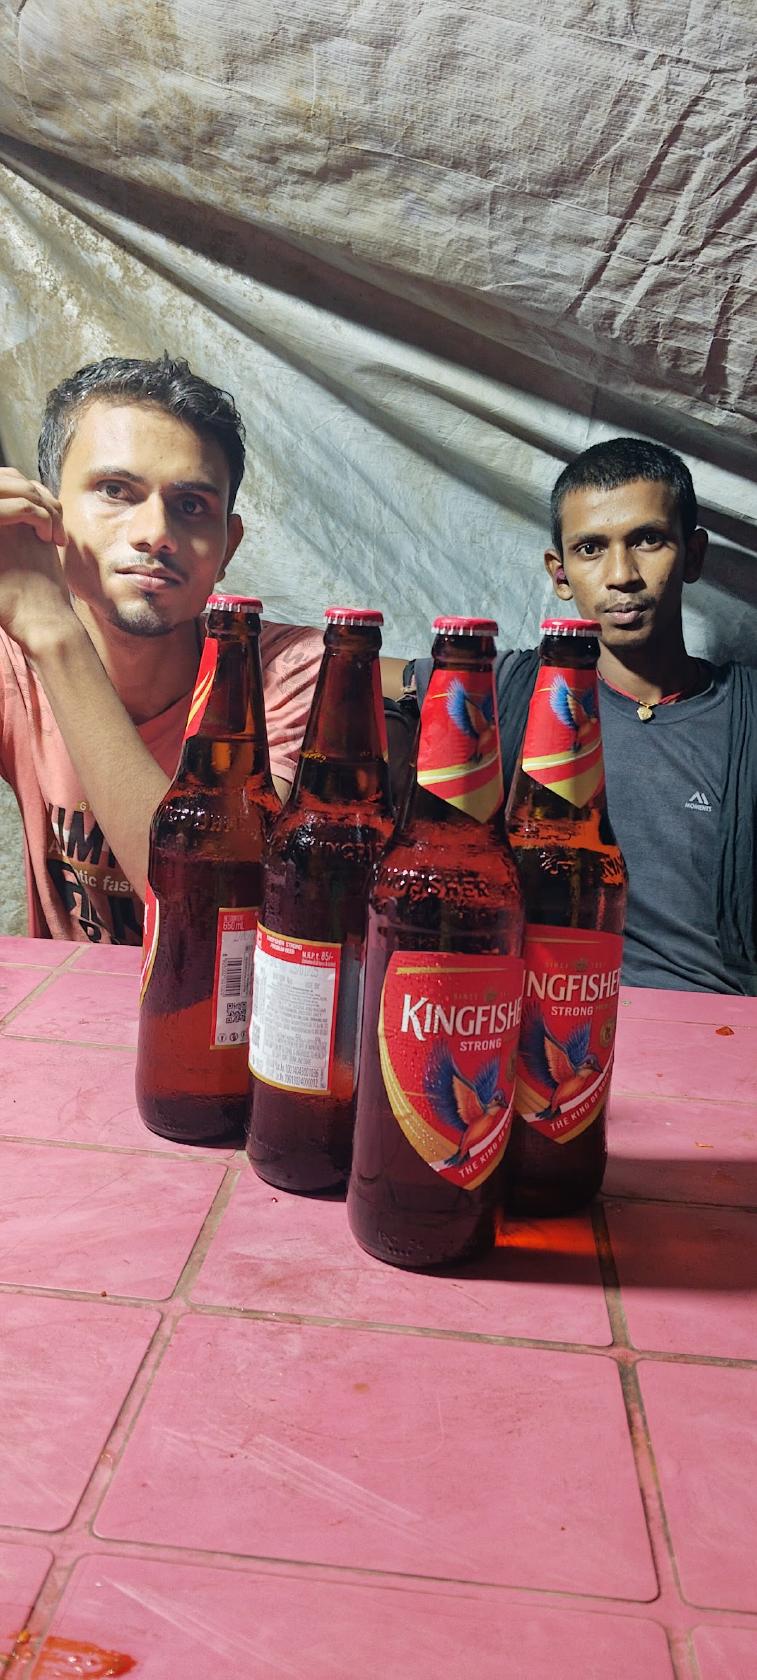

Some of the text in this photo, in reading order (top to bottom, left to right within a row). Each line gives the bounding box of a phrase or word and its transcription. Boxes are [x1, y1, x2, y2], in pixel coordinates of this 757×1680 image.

[551, 1006, 594, 1017] STRONG
[459, 1038, 502, 1053] STRONG
[550, 1117, 570, 1132] THE
[570, 1102, 590, 1121] KING
[458, 1160, 479, 1178] THE
[479, 1142, 498, 1164] KING
